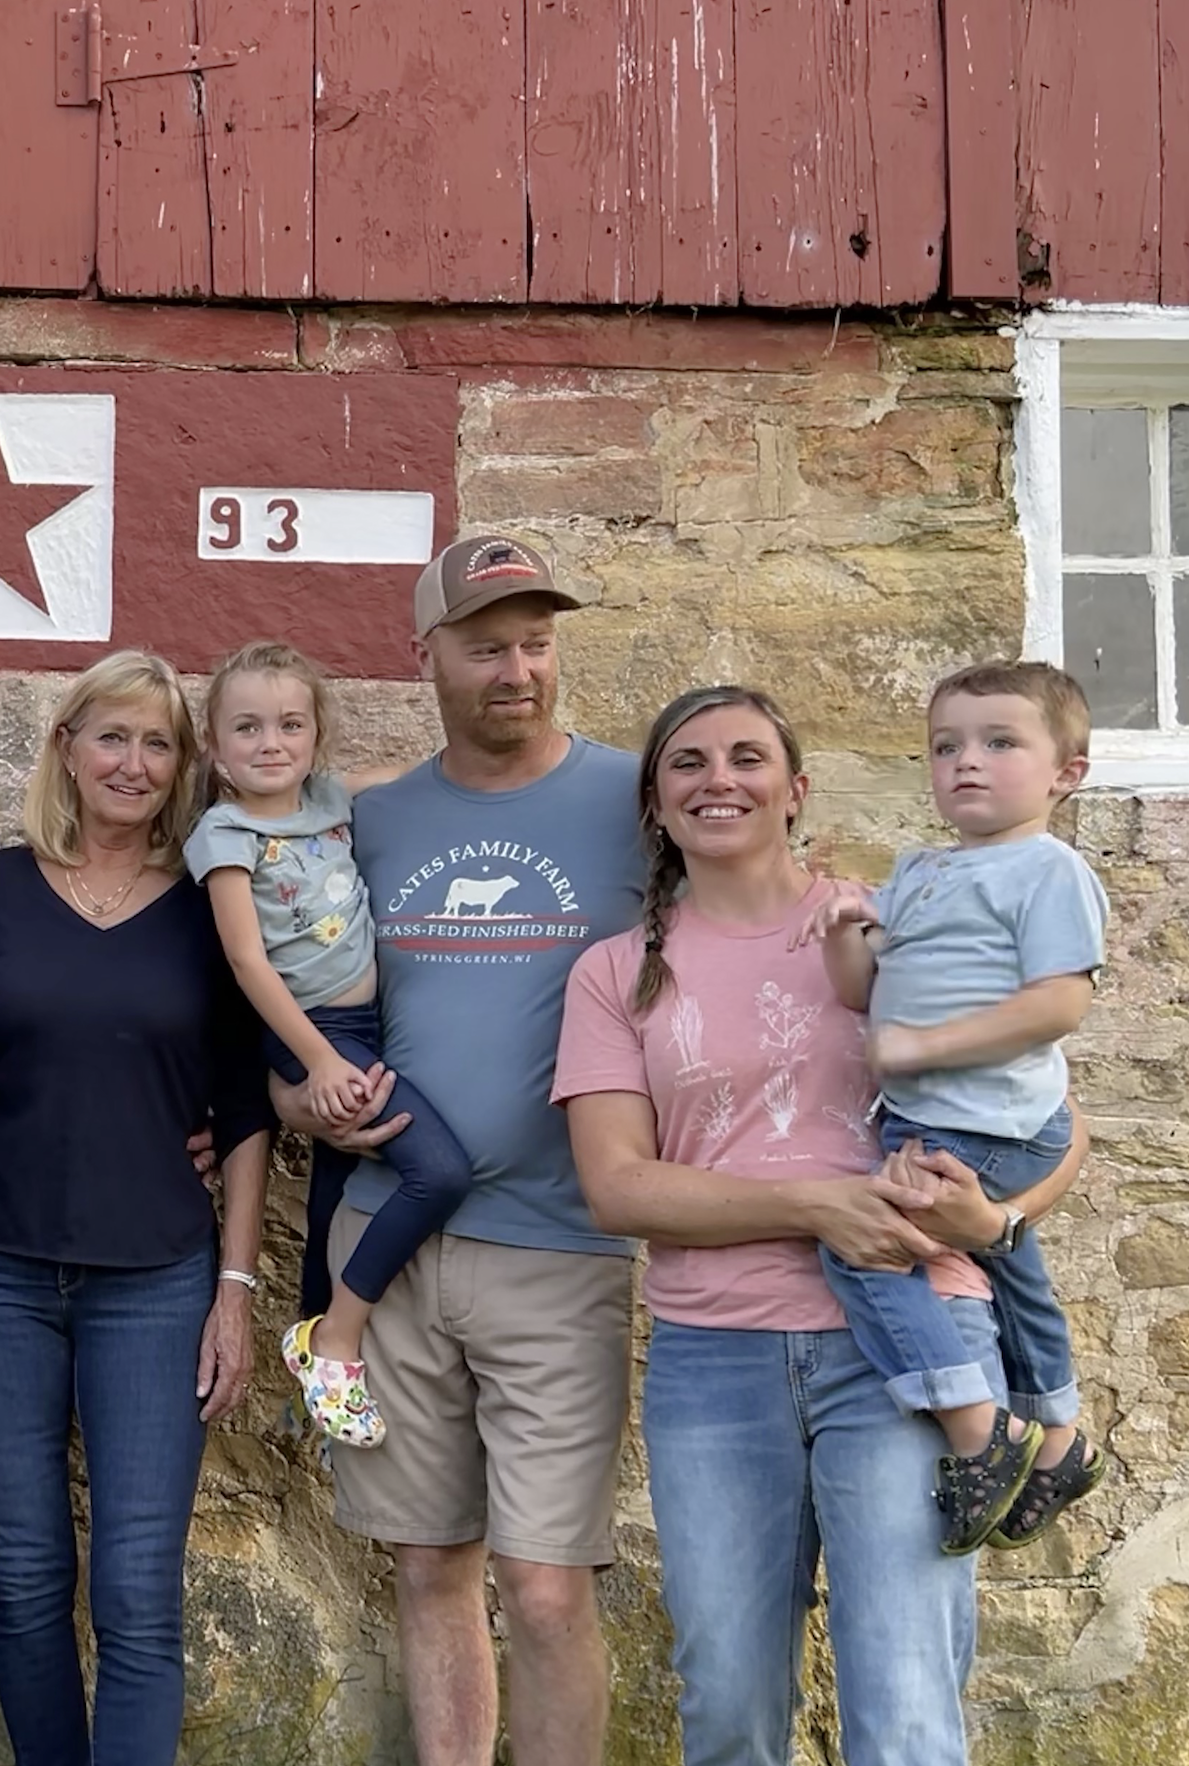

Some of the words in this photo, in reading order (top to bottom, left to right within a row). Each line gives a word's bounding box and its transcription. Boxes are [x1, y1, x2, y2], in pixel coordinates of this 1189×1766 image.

[209, 497, 298, 552] 93
[388, 857, 445, 912] CATES
[448, 840, 539, 865] FAMILY
[534, 857, 579, 913] FARM
[462, 924, 543, 937] FINISHED
[545, 924, 589, 938] BEEF
